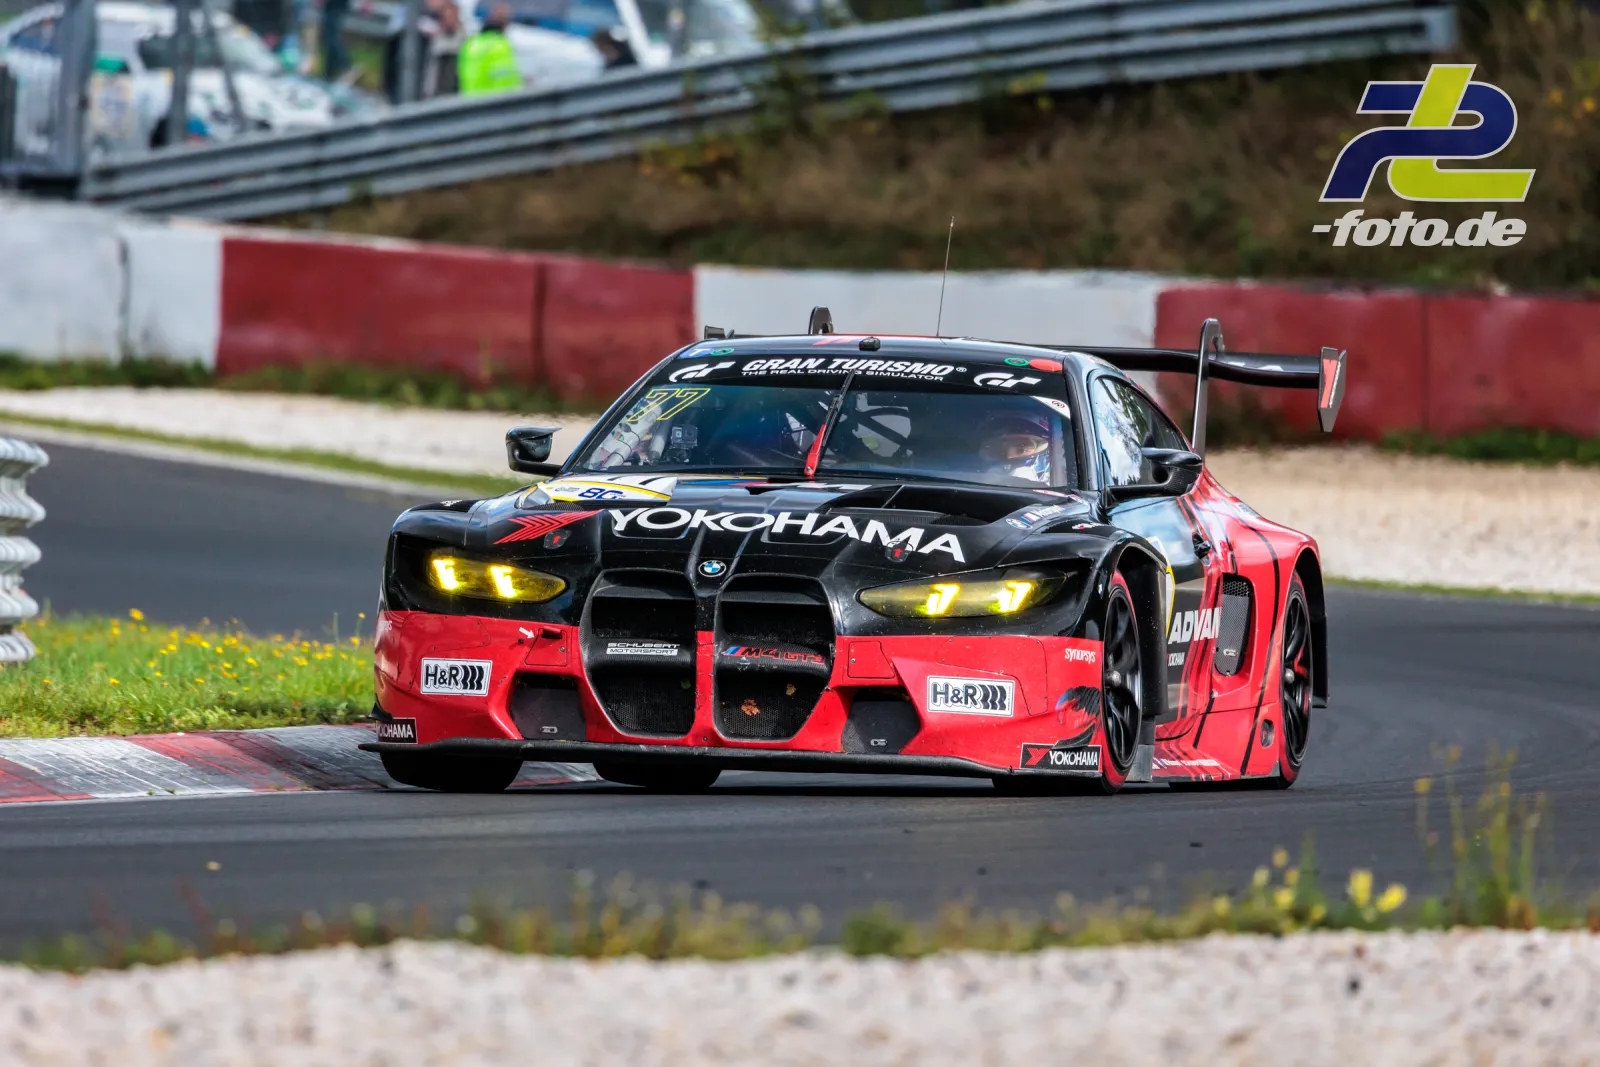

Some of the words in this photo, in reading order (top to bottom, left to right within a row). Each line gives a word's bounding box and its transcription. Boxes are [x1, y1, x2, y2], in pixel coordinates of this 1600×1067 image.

[742, 358, 826, 371] GRAN
[865, 370, 943, 381] SIMULATOR
[626, 387, 711, 422] 77
[608, 507, 966, 563] YOKOHAMA
[425, 663, 461, 690] H&R
[931, 682, 982, 709] H&R
[1049, 750, 1099, 766] YOKOHAMA
